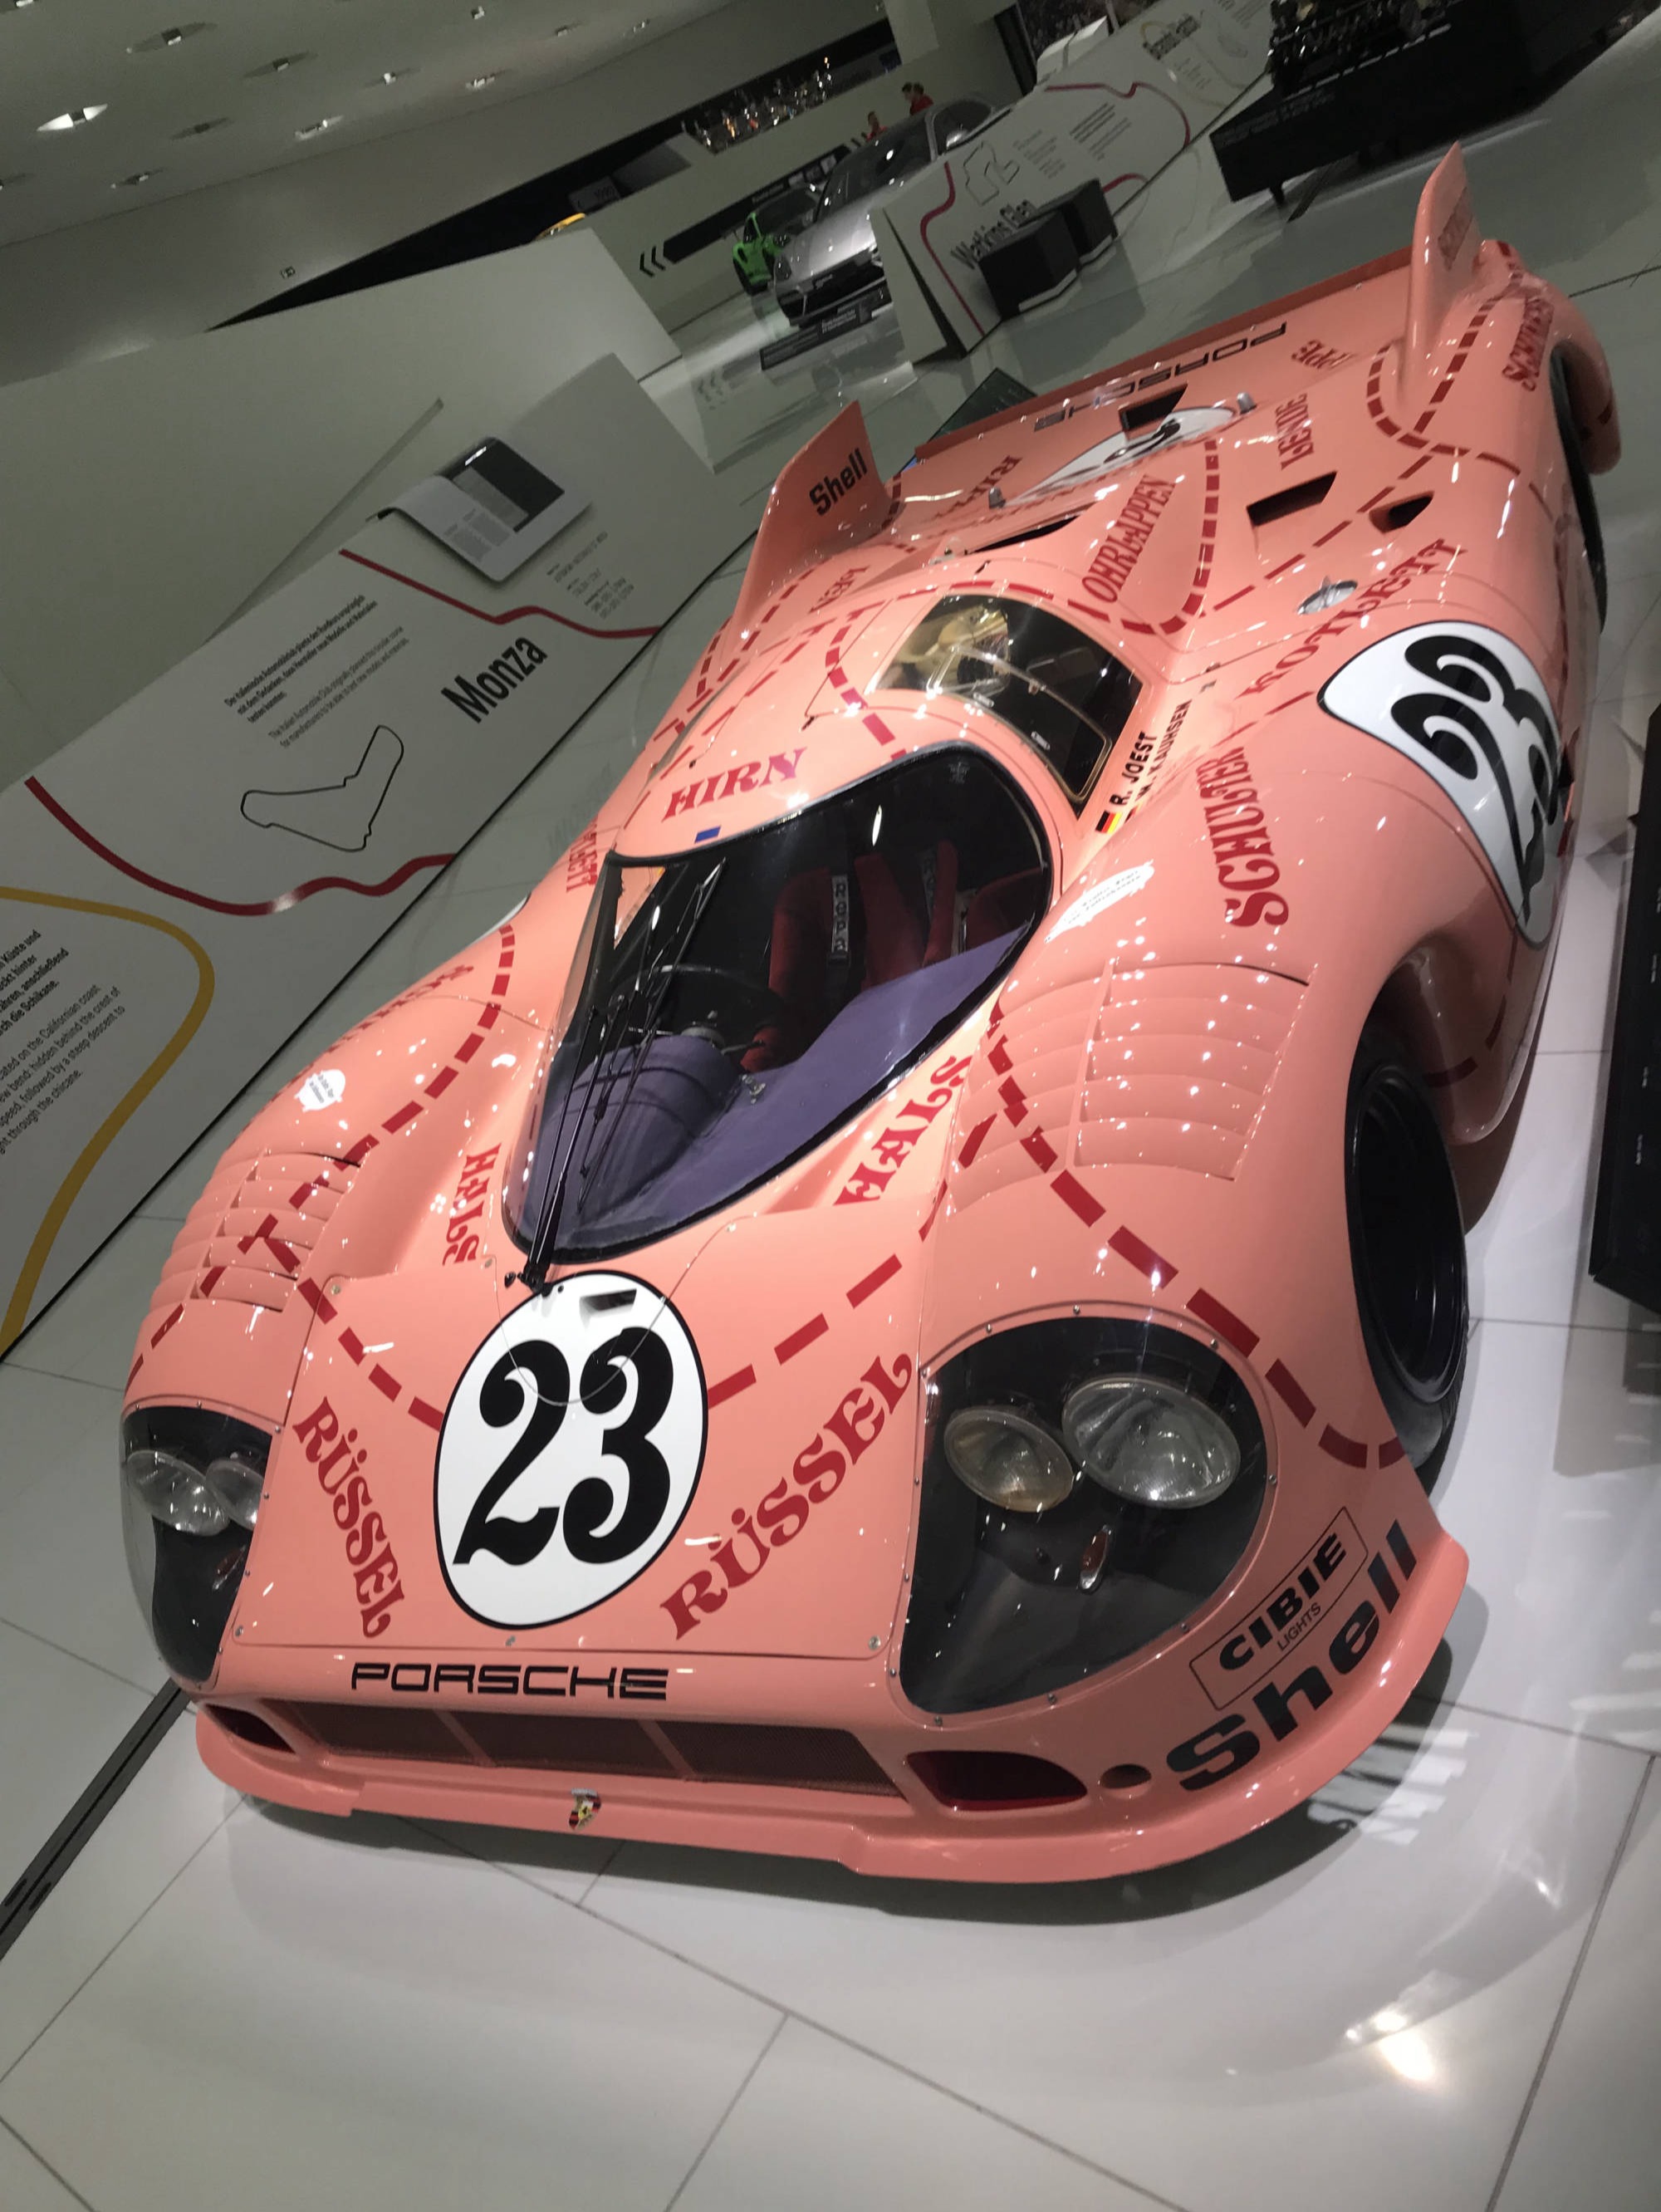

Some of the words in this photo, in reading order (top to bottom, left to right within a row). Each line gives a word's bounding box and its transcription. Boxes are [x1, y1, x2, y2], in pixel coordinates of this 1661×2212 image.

[809, 449, 867, 516] Shell
[1081, 473, 1177, 604] OHRLAPPEN
[441, 637, 548, 723] Monza
[1234, 538, 1467, 699] KOTLETT
[662, 750, 807, 822] HIRN
[1109, 791, 1133, 806] R.
[1121, 731, 1157, 783] JOEST
[1391, 635, 1563, 924] 23
[1196, 747, 1289, 929] SCHULTER
[833, 1057, 973, 1205] HALS
[442, 1142, 502, 1267] HALS
[453, 1327, 674, 1565] 23
[659, 1351, 914, 1641] RÜSSEL
[292, 1395, 405, 1639] RÜSSEL
[1165, 1519, 1417, 1792] Shell
[1218, 1533, 1347, 1671] CIBIE
[1276, 1601, 1322, 1652] LIGHTS
[351, 1662, 670, 1700] PORSCHE
